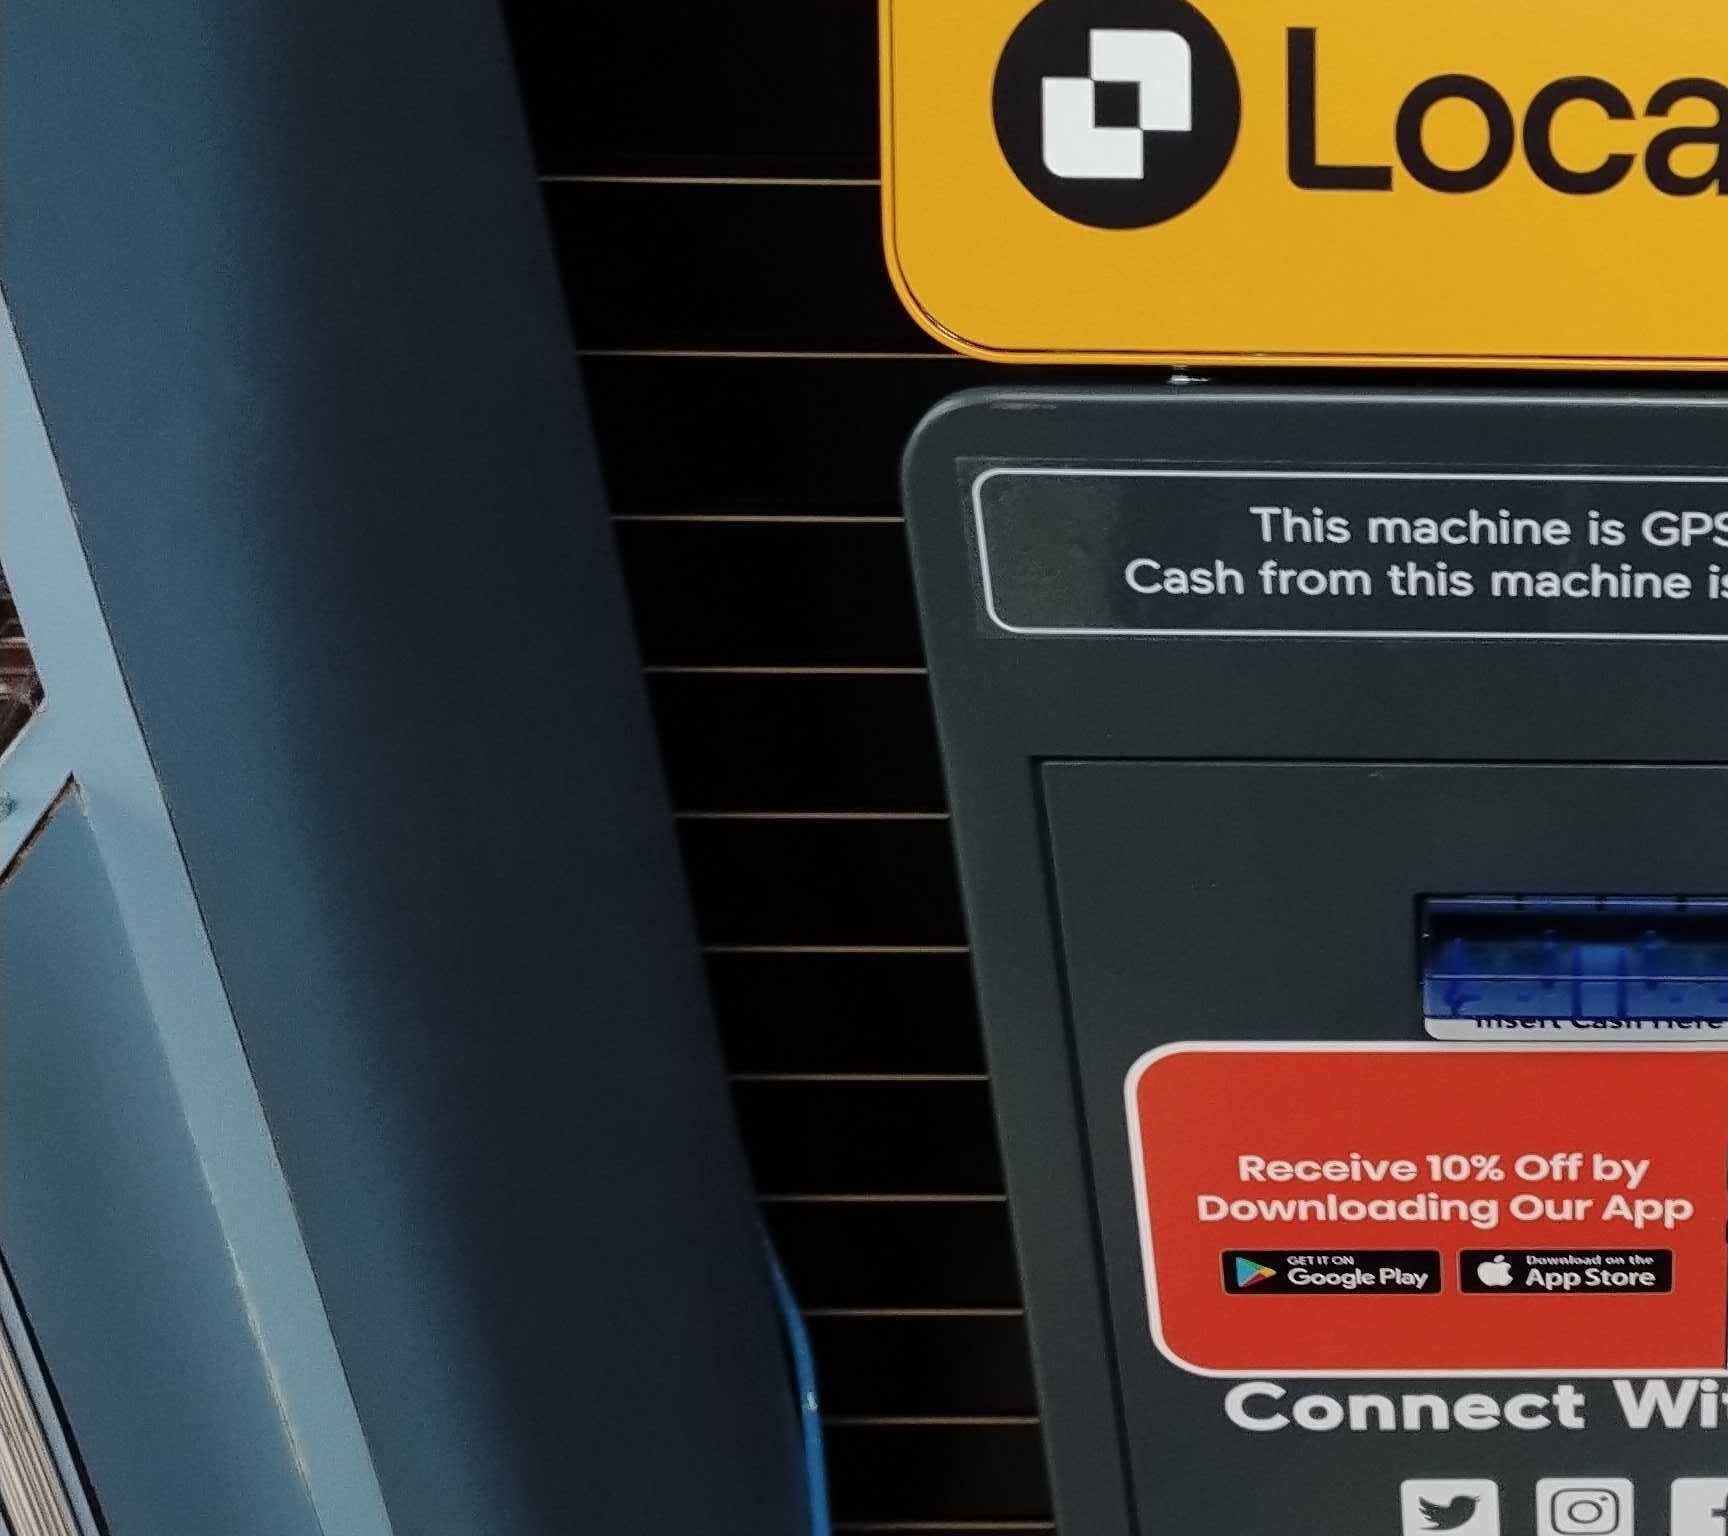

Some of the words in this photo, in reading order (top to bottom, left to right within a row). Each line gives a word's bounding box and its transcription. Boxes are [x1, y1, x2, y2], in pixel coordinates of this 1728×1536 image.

[1250, 507, 1350, 543] This
[1369, 509, 1571, 545] machine
[1589, 511, 1625, 545] is
[1125, 559, 1244, 594] Cash
[1259, 560, 1371, 595] from
[1387, 562, 1473, 596] this
[1492, 564, 1691, 598] machine
[1239, 1153, 1417, 1181] Receive
[1426, 1155, 1505, 1181] 10%
[1515, 1153, 1582, 1180] Off
[1593, 1154, 1649, 1189] by
[1198, 1192, 1498, 1229] Downloading
[1510, 1195, 1593, 1220] Our
[1602, 1195, 1693, 1228] App
[1287, 1255, 1316, 1266] GET
[1318, 1255, 1329, 1265] IT
[1332, 1255, 1354, 1265] ON
[1526, 1254, 1602, 1266] Download
[1605, 1256, 1624, 1266] on
[1629, 1255, 1654, 1266] the
[1288, 1267, 1375, 1289] Google
[1380, 1267, 1428, 1290] Play
[1526, 1268, 1581, 1291] App
[1585, 1267, 1656, 1287] Store
[1224, 1380, 1586, 1432] Connect
